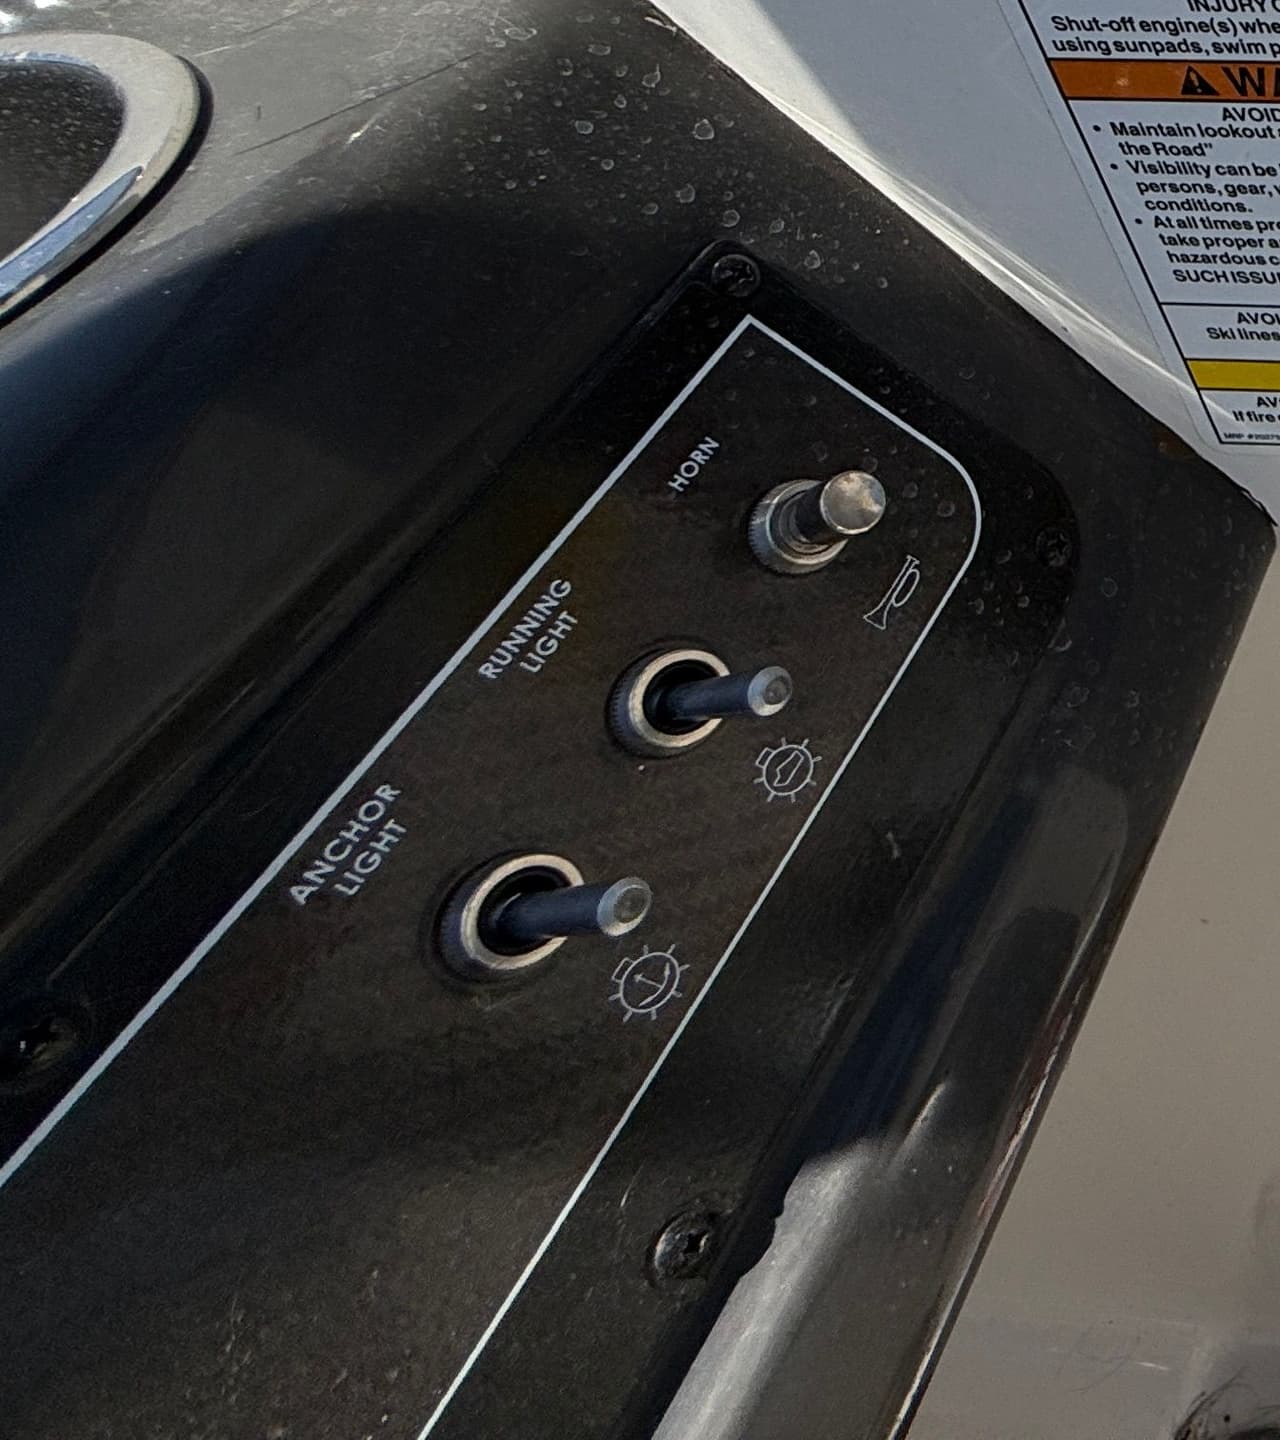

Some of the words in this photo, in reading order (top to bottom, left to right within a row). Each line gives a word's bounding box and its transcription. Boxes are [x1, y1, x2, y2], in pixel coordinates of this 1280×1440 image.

[668, 437, 719, 491] HORN
[478, 580, 571, 679] RUNNING
[520, 611, 578, 672] LIGHT
[290, 785, 400, 905] ANCHOR
[334, 819, 406, 895] LIGHT
